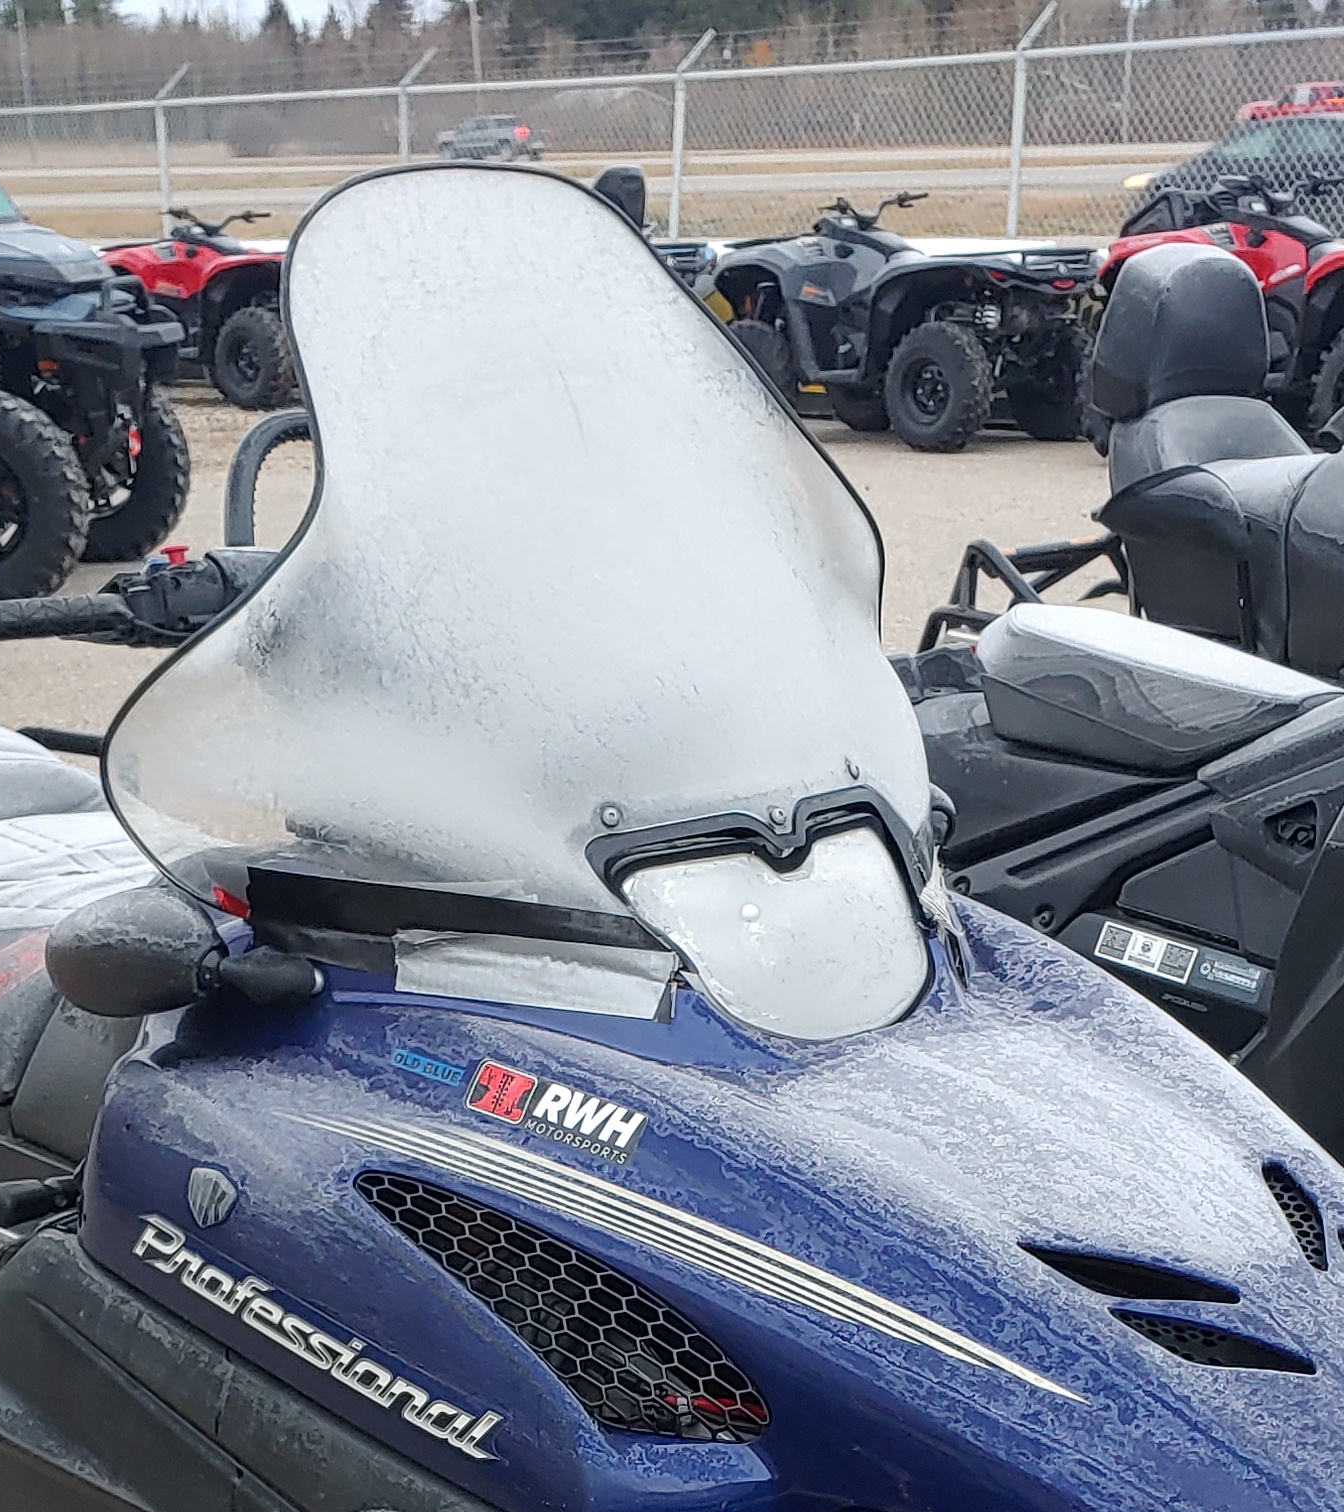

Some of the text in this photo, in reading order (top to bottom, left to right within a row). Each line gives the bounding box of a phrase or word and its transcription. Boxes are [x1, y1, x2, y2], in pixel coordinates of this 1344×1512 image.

[393, 1051, 462, 1084] OLD BLUE
[525, 1119, 628, 1166] MOTORSPORTS
[532, 1083, 646, 1150] RWH
[132, 1213, 505, 1461] Professional
